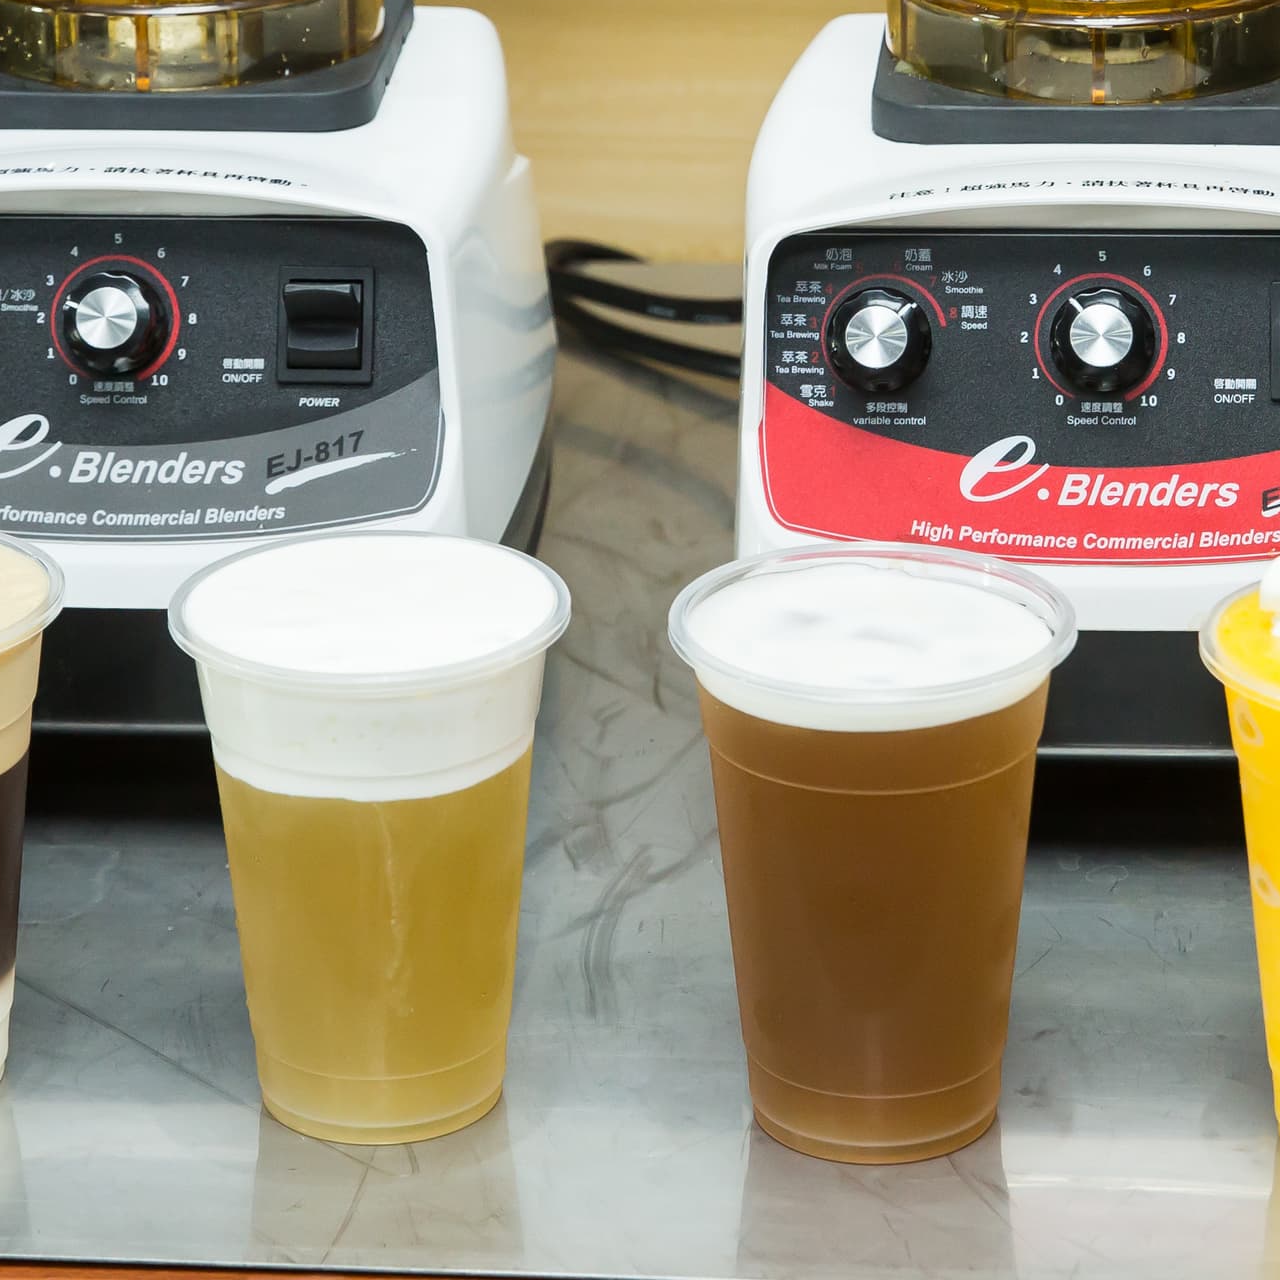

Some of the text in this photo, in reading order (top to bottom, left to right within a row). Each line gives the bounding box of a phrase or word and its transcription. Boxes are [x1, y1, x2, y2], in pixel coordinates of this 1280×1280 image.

[115, 234, 122, 245] 5
[70, 246, 78, 257] 4
[157, 248, 166, 259] 6
[1098, 251, 1106, 262] 5
[830, 263, 852, 271] Foam
[905, 263, 933, 272] Cream
[1053, 264, 1062, 275] 4
[1143, 265, 1152, 277] 6
[46, 275, 55, 286] 3
[181, 276, 189, 287] 7
[945, 286, 984, 295] Smoothie
[776, 295, 826, 305] Tea Brewing
[1029, 293, 1038, 305] 3
[1168, 294, 1177, 306] 7
[36, 312, 45, 324] 2
[188, 313, 197, 324] 8
[949, 308, 957, 319] 8
[961, 321, 988, 331] Speed
[770, 331, 820, 341] Tea Brewing
[1020, 331, 1029, 343] 2
[1177, 332, 1186, 344] 8
[46, 348, 55, 359] 1
[177, 348, 186, 360] 9
[811, 352, 819, 363] 2
[775, 366, 825, 376] Tea Brewing
[1031, 368, 1039, 379] 1
[1166, 368, 1176, 380] 9
[69, 374, 77, 386] 0
[151, 374, 168, 386] 10
[222, 373, 263, 383] ON/OFF
[80, 394, 148, 405] Speed Control
[298, 397, 340, 408] POWER
[808, 398, 834, 407] Shake
[1055, 394, 1064, 406] 0
[1140, 395, 1158, 407] 10
[1214, 393, 1255, 404] ON/OFF
[853, 416, 927, 426] variable control
[1066, 415, 1137, 427] Speed Control
[266, 430, 366, 479] EJ-817
[92, 507, 201, 527] Commercial
[204, 504, 286, 524] Blenders
[910, 519, 957, 543] High
[958, 526, 1078, 549] Performance
[1082, 533, 1194, 550] Commercial
